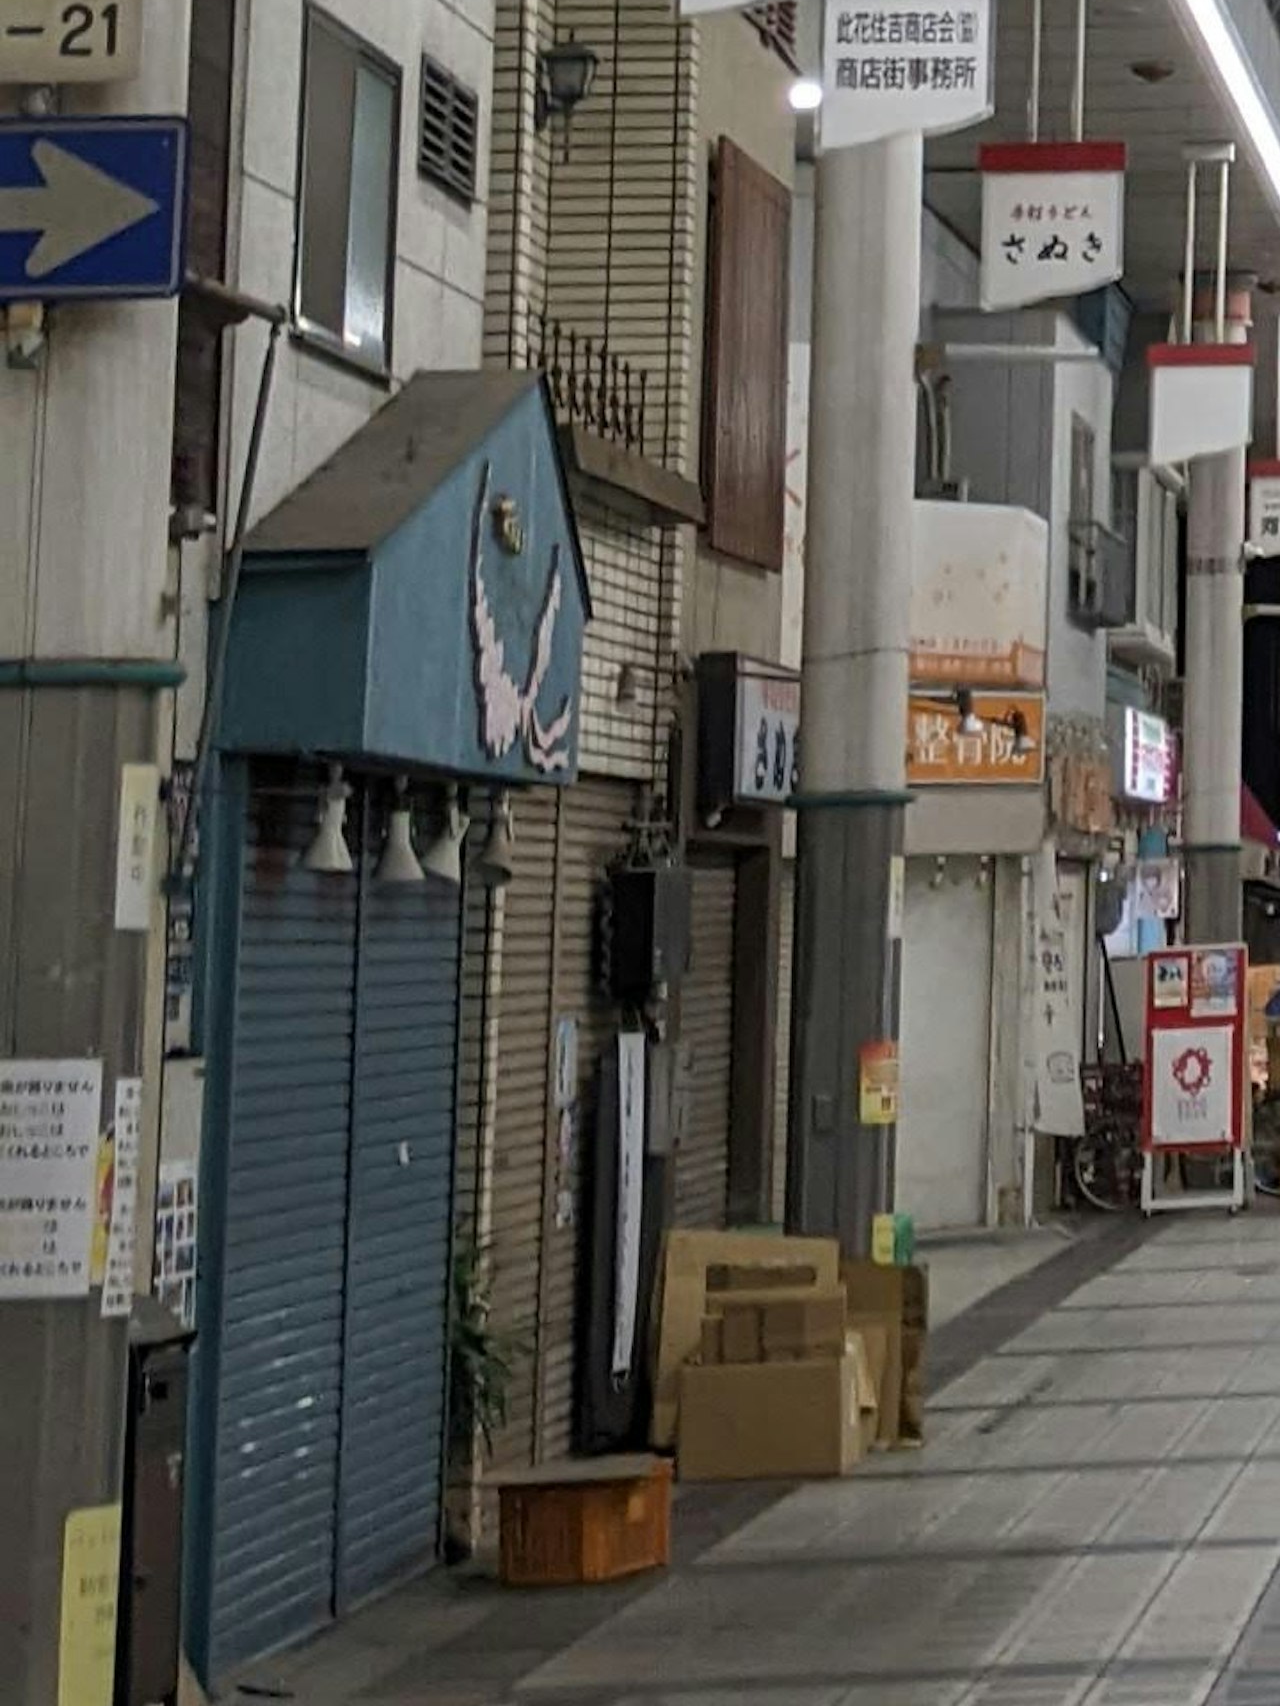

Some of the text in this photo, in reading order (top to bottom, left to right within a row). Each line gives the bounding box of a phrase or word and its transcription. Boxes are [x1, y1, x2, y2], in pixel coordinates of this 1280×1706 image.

[836, 56, 977, 89] 商店街事務所
[1002, 232, 1102, 264] さぬき
